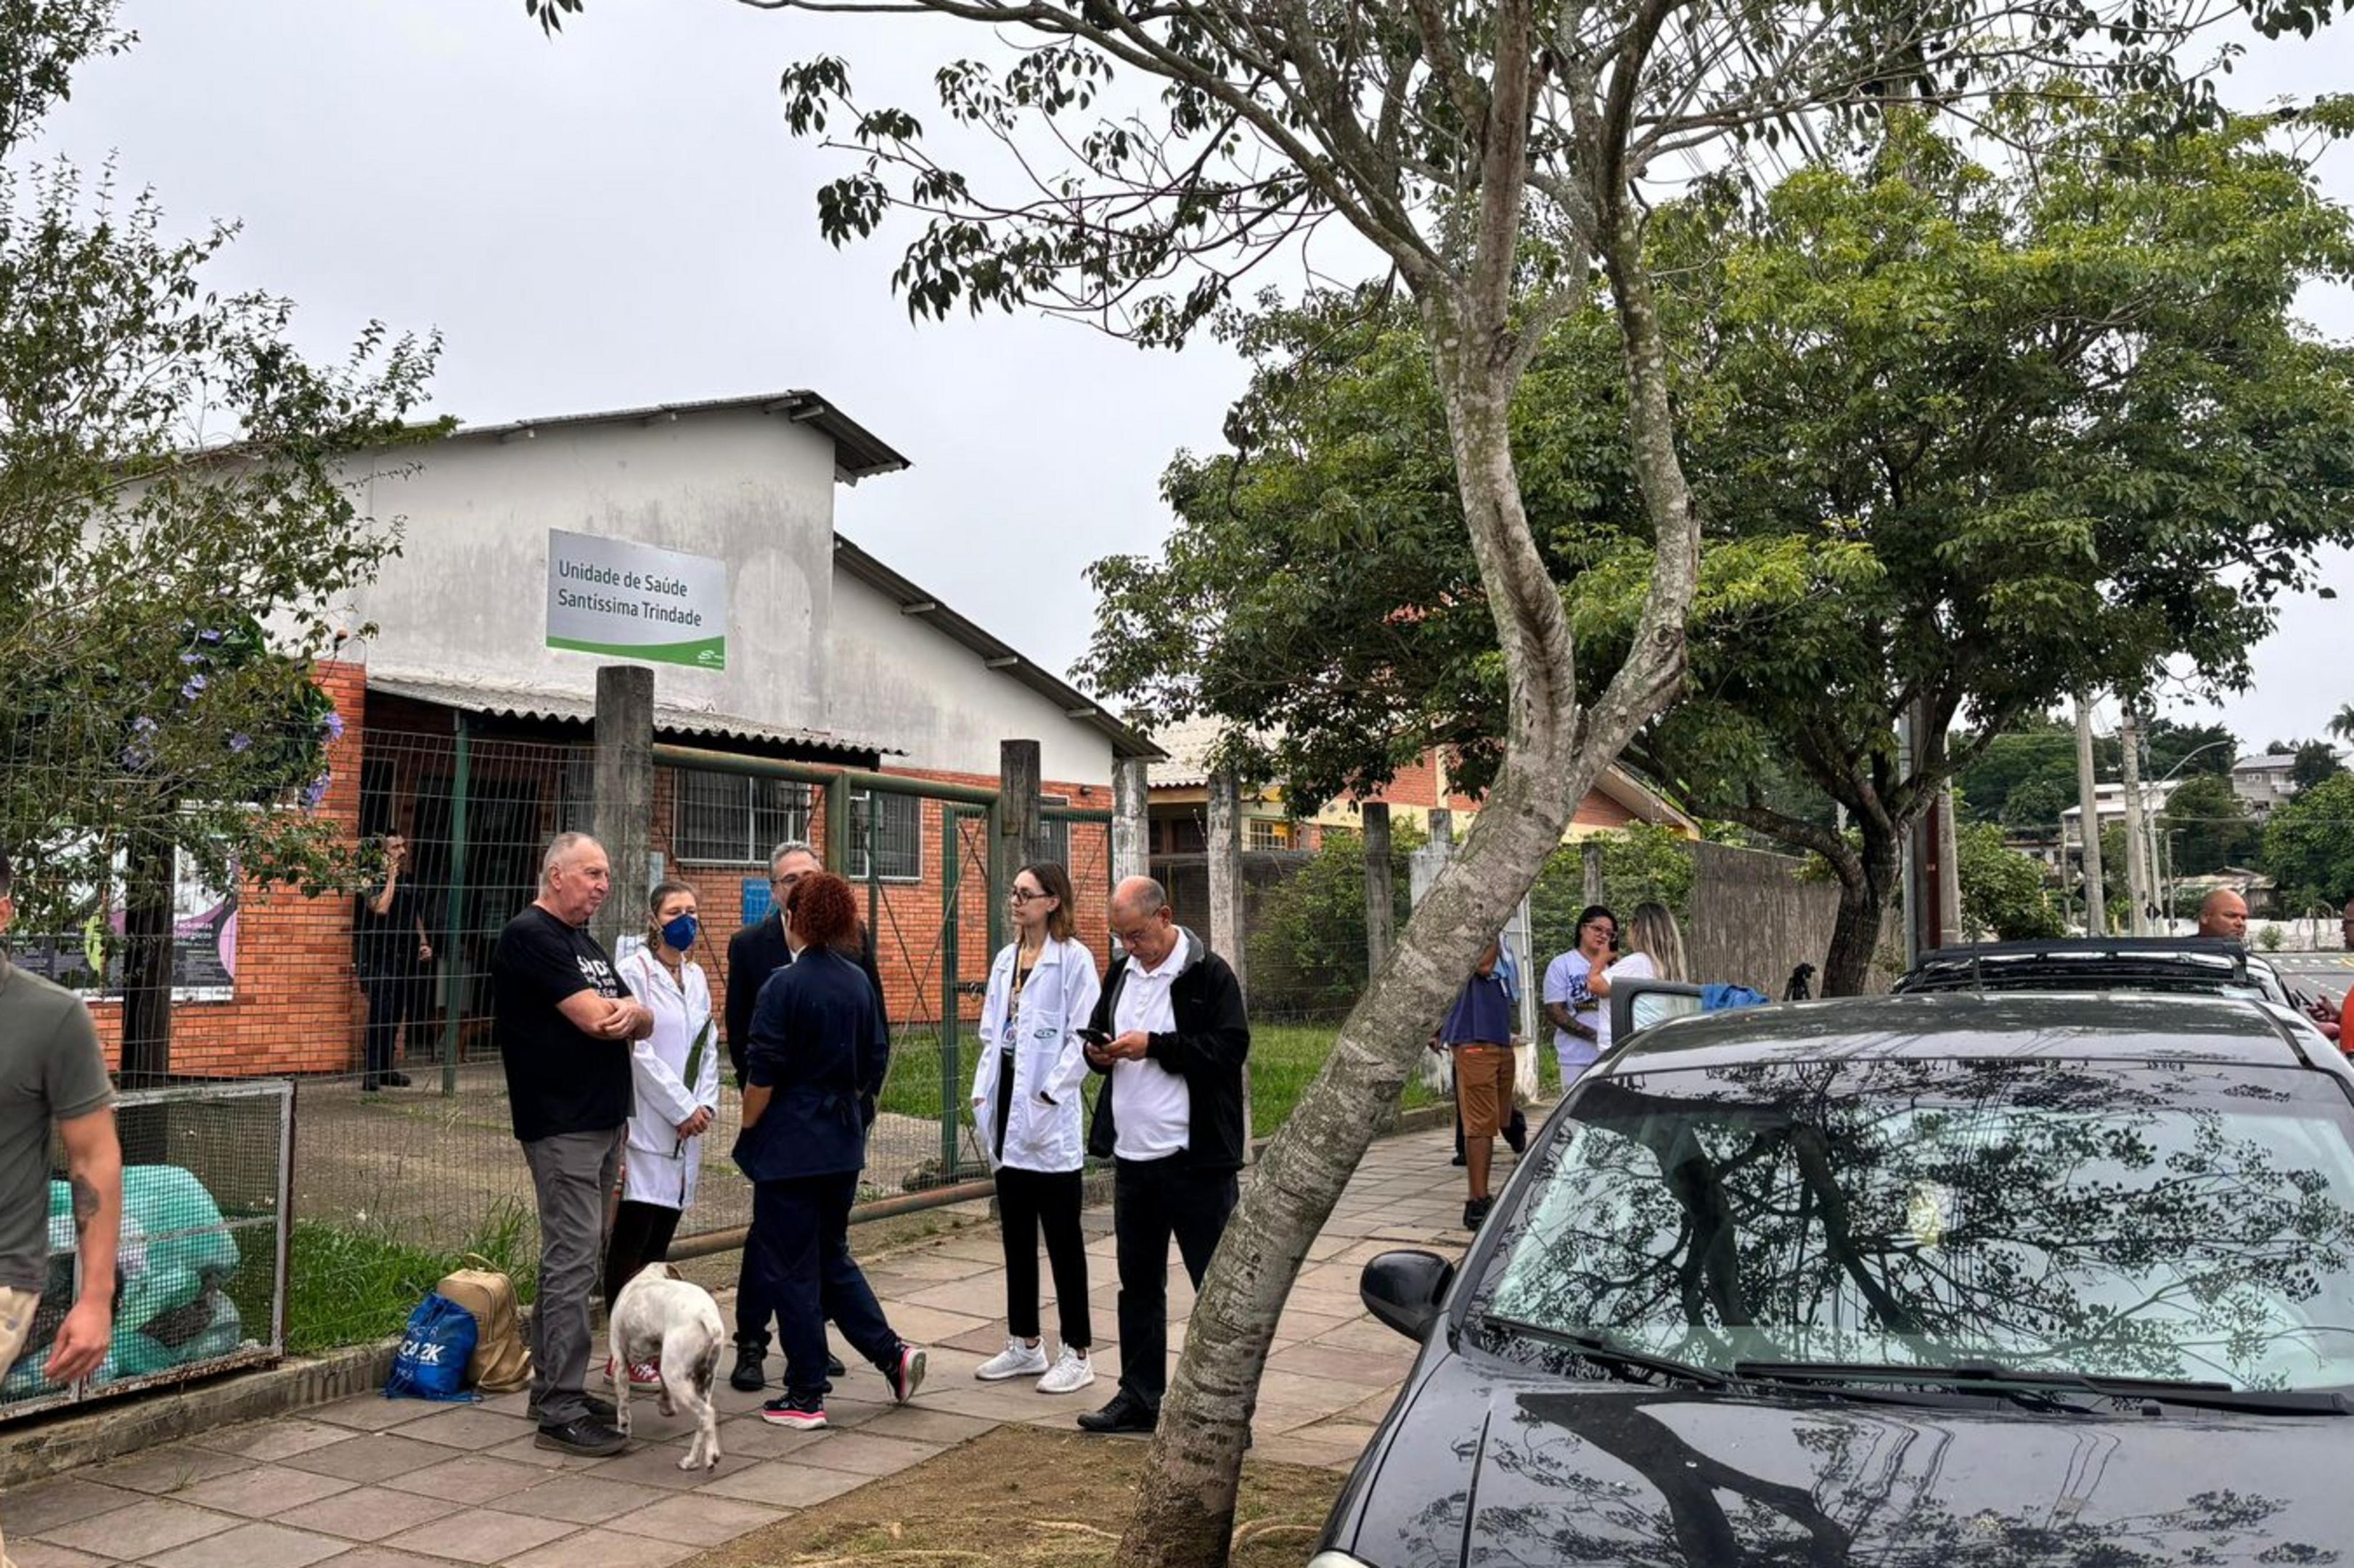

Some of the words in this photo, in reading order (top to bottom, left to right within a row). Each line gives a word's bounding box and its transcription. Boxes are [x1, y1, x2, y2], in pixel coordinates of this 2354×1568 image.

[559, 559, 620, 586] Unidade
[624, 571, 640, 589] de
[645, 574, 687, 597] Saúde
[642, 601, 702, 626] Trindade
